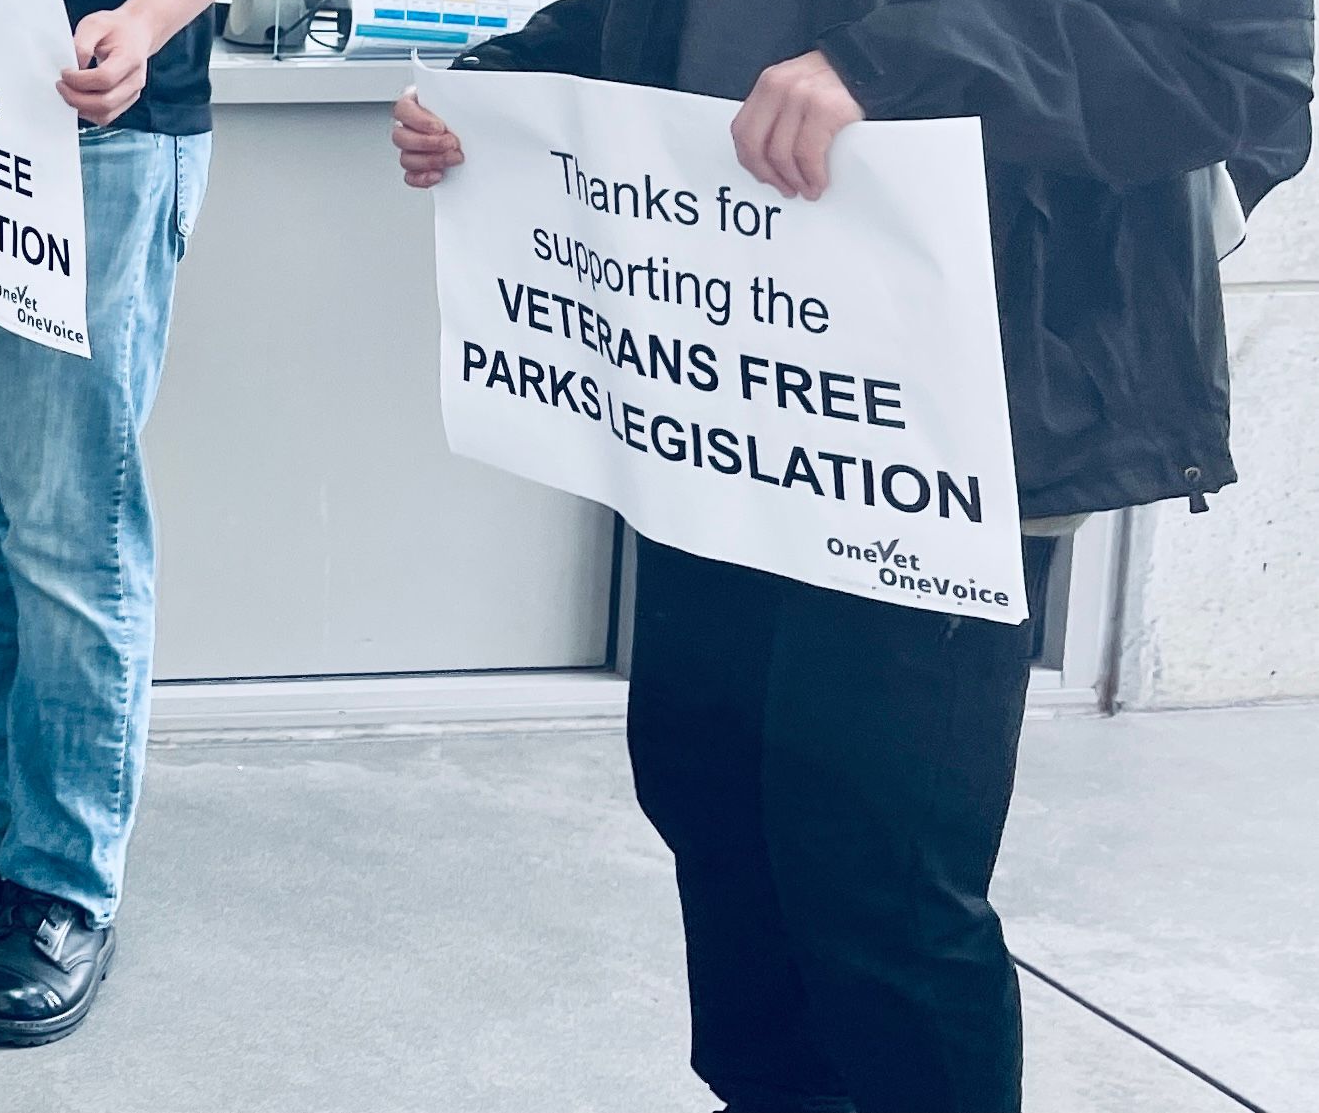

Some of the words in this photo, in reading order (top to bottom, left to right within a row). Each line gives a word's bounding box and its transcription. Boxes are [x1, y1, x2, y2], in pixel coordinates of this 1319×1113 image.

[550, 150, 700, 227] Thanks
[716, 185, 782, 241] for
[16, 308, 84, 344] OneVoice
[533, 227, 732, 327] supporting
[750, 276, 830, 334] the
[497, 278, 719, 392] VETERANS
[739, 354, 907, 430] FREE
[463, 340, 603, 423] PARKS
[606, 390, 984, 524] LEGISLATION
[826, 537, 921, 571] OneVet
[878, 567, 1010, 609] OneVoice
